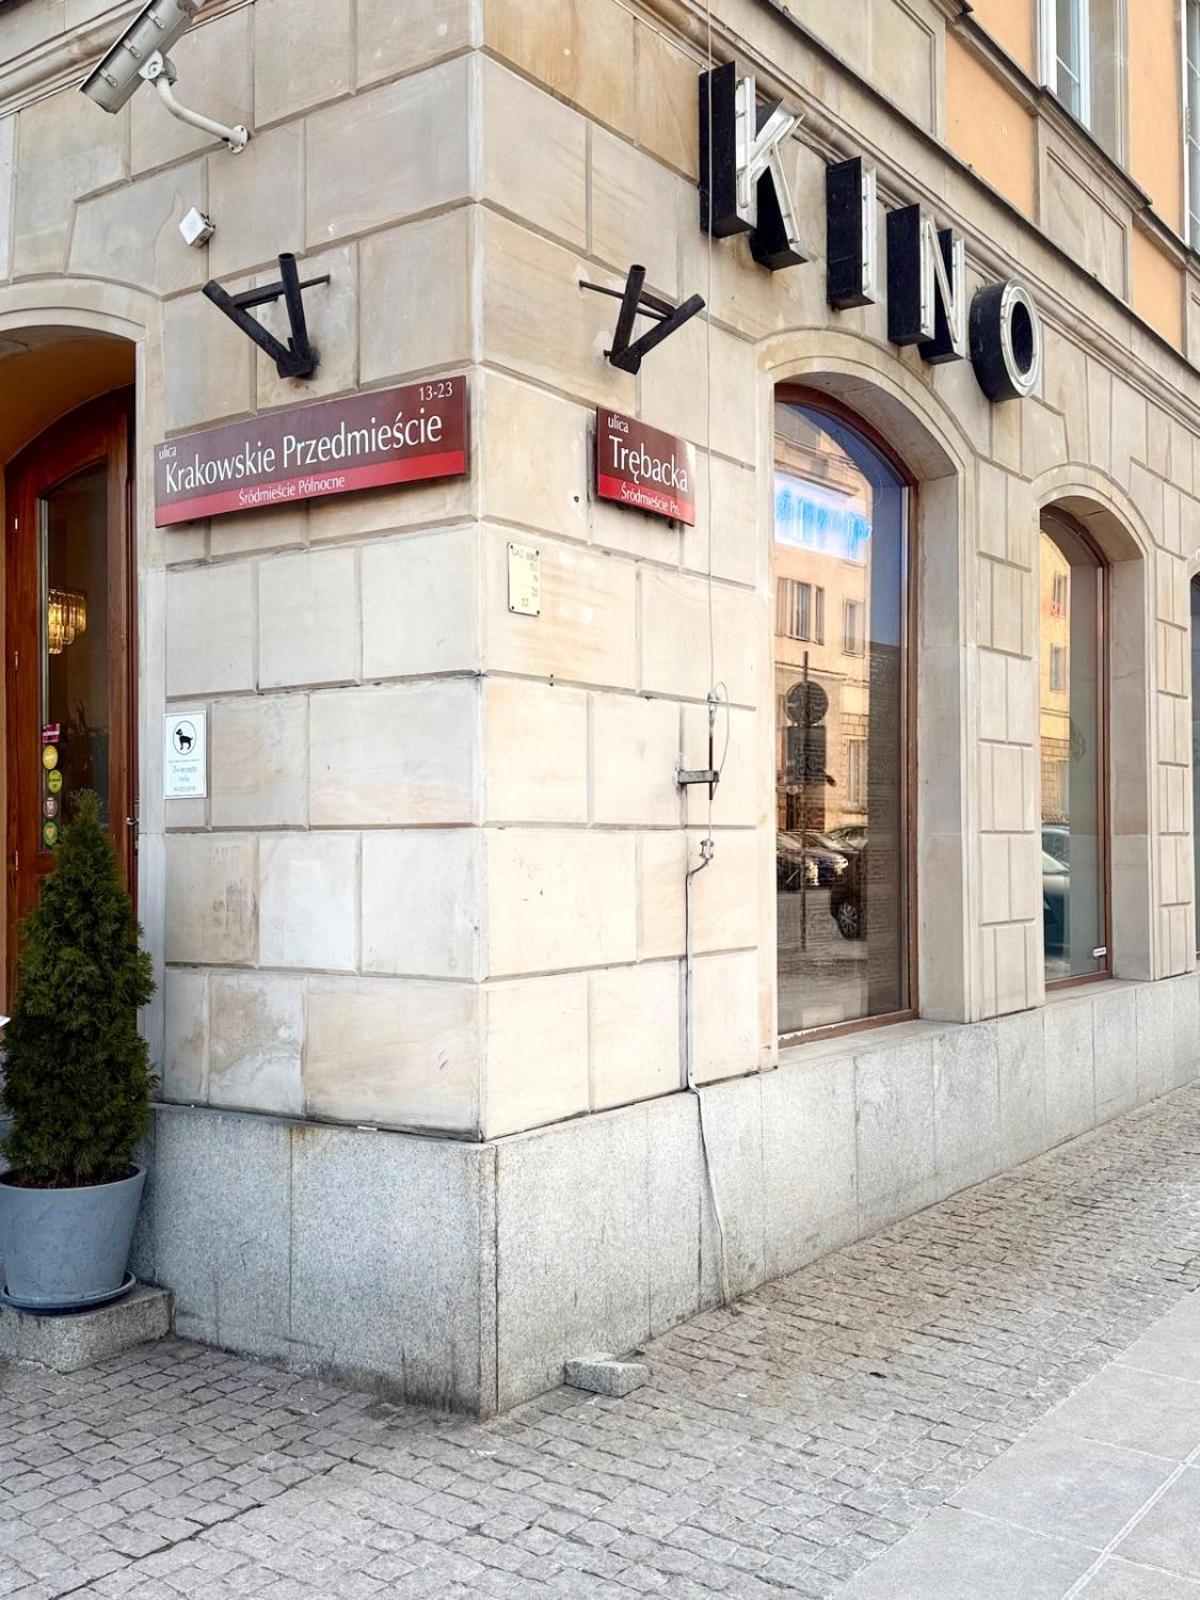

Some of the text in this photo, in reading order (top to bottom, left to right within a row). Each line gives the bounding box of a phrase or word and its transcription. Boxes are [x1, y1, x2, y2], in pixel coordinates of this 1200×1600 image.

[699, 60, 1044, 402] KINO
[418, 381, 453, 402] 13-23
[607, 413, 629, 433] ulica
[158, 444, 177, 461] ulica
[165, 408, 442, 494] Krakowskie Przedmieście
[608, 434, 689, 493] Trębacka
[238, 474, 345, 507] Śródmieście Północne
